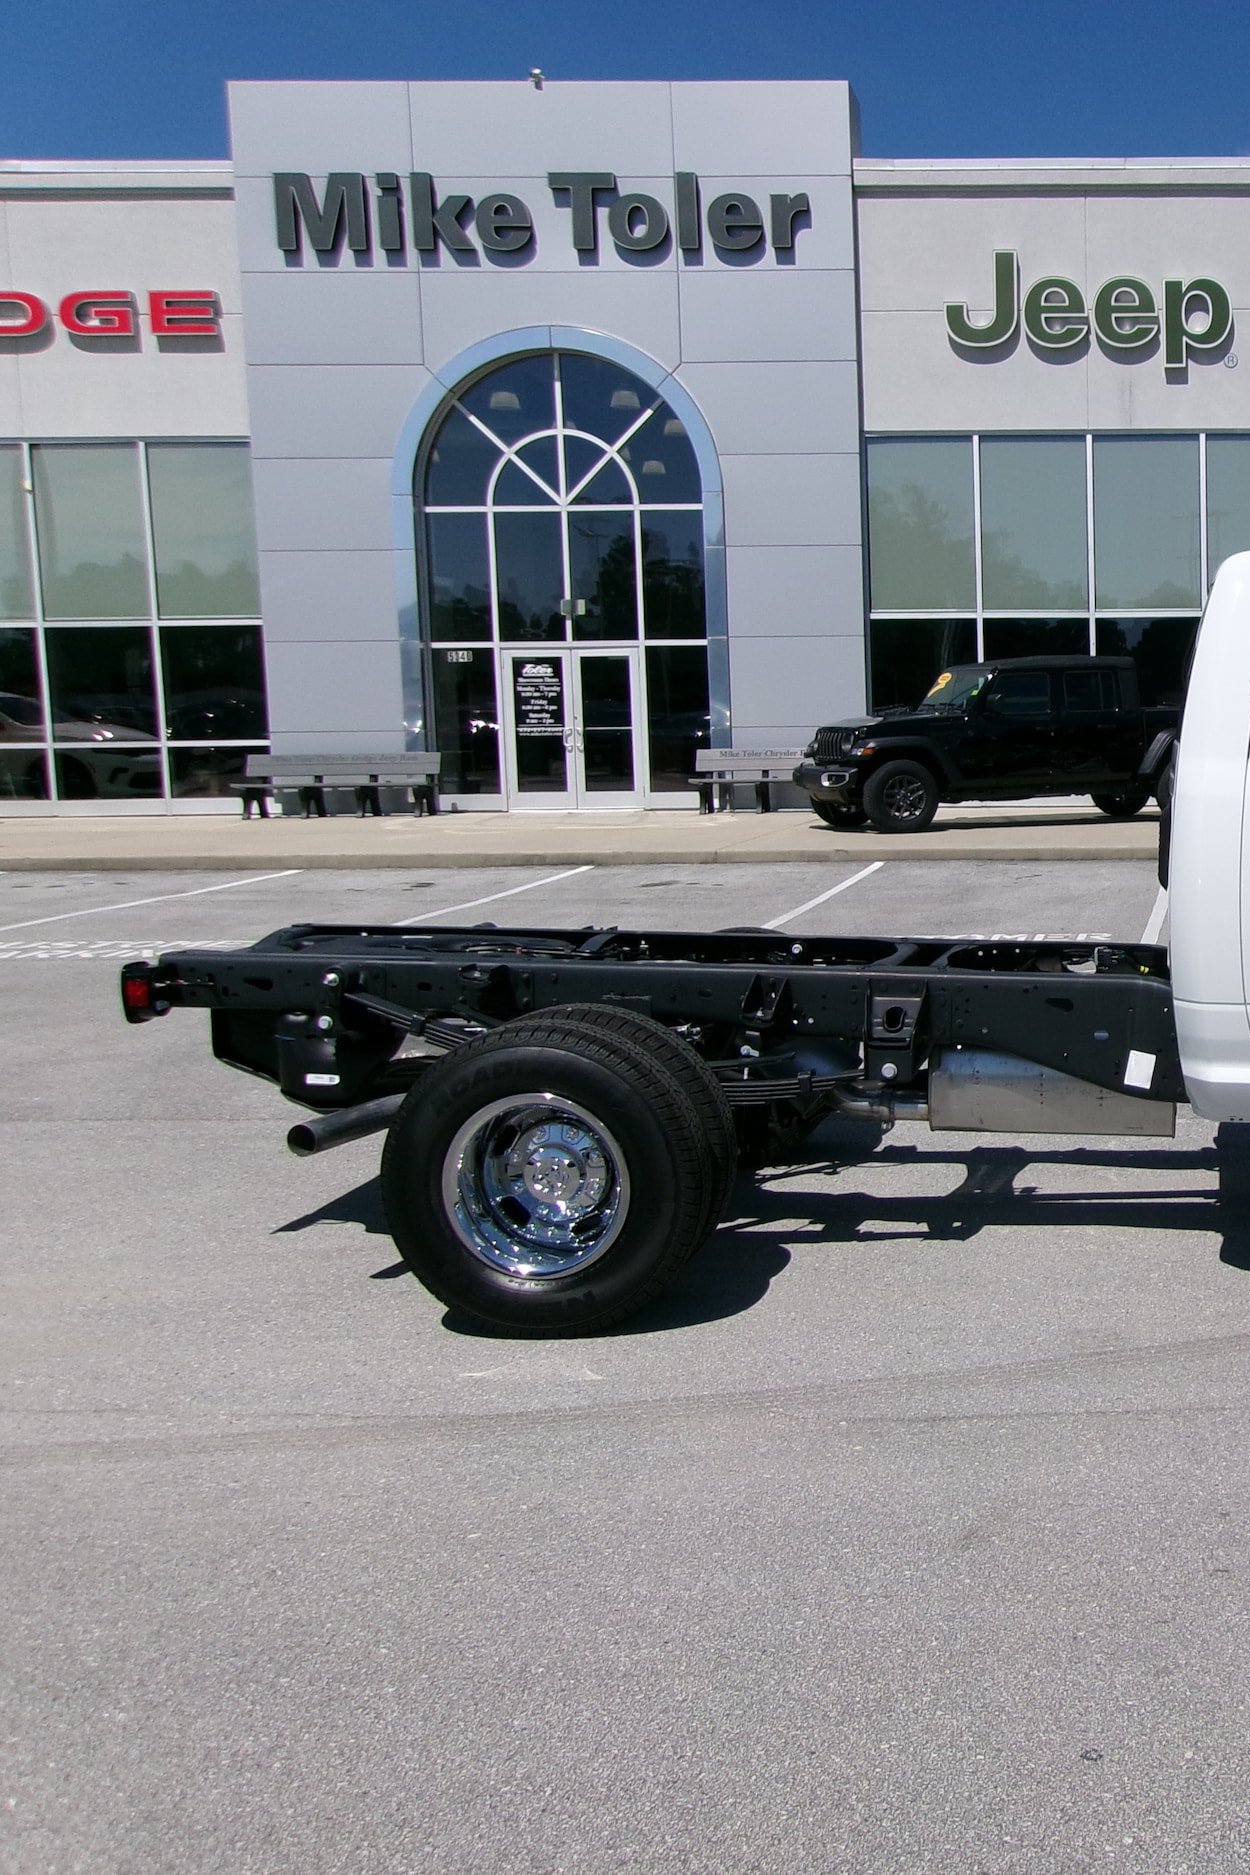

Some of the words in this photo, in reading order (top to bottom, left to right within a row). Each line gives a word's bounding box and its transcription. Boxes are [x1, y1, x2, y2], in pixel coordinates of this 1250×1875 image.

[272, 172, 532, 250] Mike
[548, 172, 809, 250] Toler
[944, 249, 1233, 367] Jeep
[719, 750, 740, 758] Mike
[742, 750, 762, 758] Toler
[764, 750, 798, 759] Chrysler
